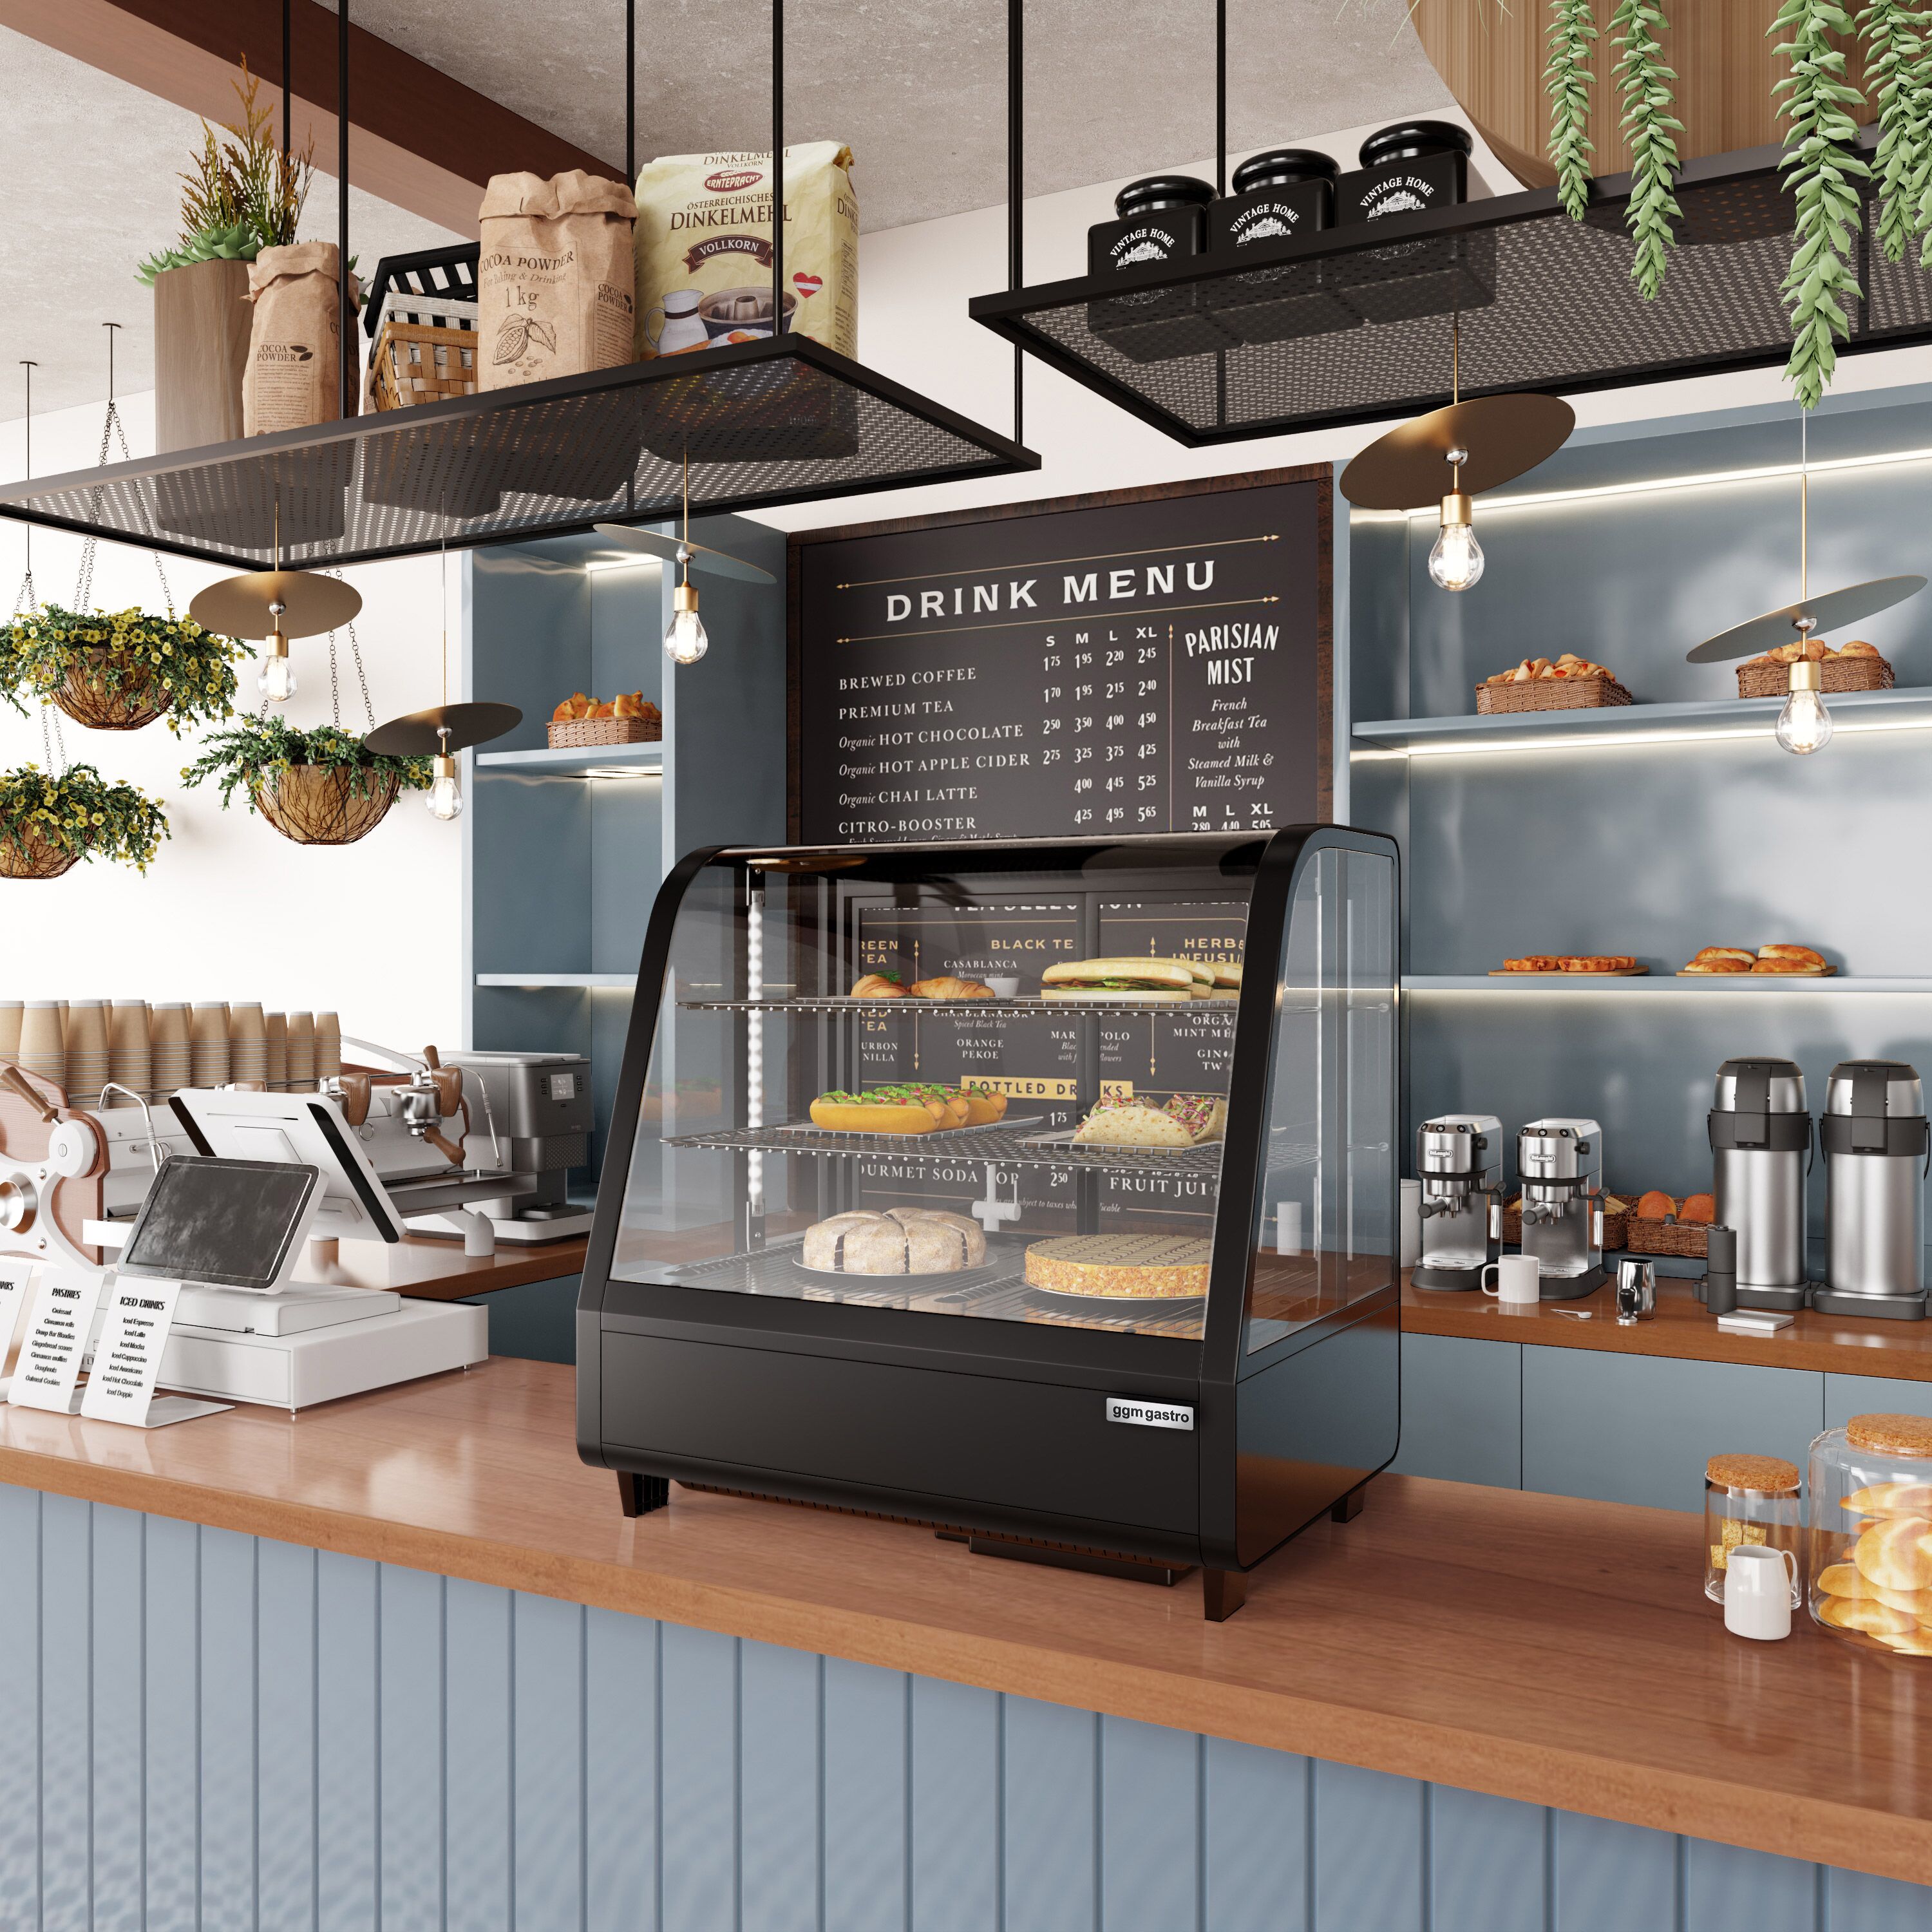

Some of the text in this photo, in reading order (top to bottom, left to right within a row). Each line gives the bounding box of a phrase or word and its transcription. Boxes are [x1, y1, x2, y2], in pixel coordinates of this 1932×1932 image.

[704, 149, 791, 166] DINKELMEL
[706, 175, 761, 189] ERNTEPRACHT
[1359, 176, 1434, 207] VINTAGE HOME
[687, 193, 773, 211] ÖSTERREICHISCHES
[1229, 203, 1300, 232] VINTAGE HOME
[699, 240, 759, 255] VOLLKORN
[1110, 228, 1175, 256] VINTAGE HOME
[480, 251, 574, 274] COCOA POWDER
[484, 278, 493, 289] For
[494, 270, 517, 284] Baking
[530, 272, 567, 285] Drinking
[506, 285, 540, 311] 1 kg
[598, 283, 623, 300] COCOA
[598, 292, 628, 313] POWDER
[258, 345, 287, 354] COCOA
[257, 353, 296, 362] POWDER
[886, 560, 1215, 621] DRINK MENU
[1046, 627, 1157, 647] S M L XL
[1185, 623, 1279, 657] PARISIAN
[1208, 657, 1255, 685] MIST
[839, 674, 905, 690] BREWED
[912, 668, 976, 685] COFFEE
[839, 703, 915, 719] PREMIUM
[922, 701, 953, 713] TEA
[1211, 697, 1247, 712] French
[1192, 715, 1267, 734] Breakfast Tea
[839, 735, 875, 751] Organic
[880, 732, 913, 745] HOT
[918, 724, 1023, 743] CHOCOLATE
[1218, 736, 1240, 749] with
[839, 763, 875, 779] Organic
[880, 761, 913, 773] HOT
[918, 757, 969, 772] APPLE
[976, 753, 1030, 768] CIDER
[1188, 753, 1274, 770] Steamed Milk &
[1195, 774, 1265, 790] Vanilla Syrup
[839, 792, 875, 808] Organic
[878, 790, 918, 803] CHAI
[927, 787, 978, 800] LATTE
[1193, 803, 1273, 817] M L XL
[838, 817, 976, 834] CITRO-BOOSTER
[862, 940, 898, 950] REEN
[991, 939, 1077, 949] BLACK TE
[1185, 938, 1244, 950] HERB
[862, 954, 887, 963] EA
[1173, 952, 1242, 963] INFUSI
[862, 1021, 887, 1031] EA
[954, 1020, 974, 1029] Spiced
[1051, 1031, 1076, 1039] MAR
[1173, 1028, 1206, 1037] MINT
[956, 1039, 1004, 1048] ORANGE
[863, 1053, 894, 1061] NILLA
[962, 1050, 998, 1059] PEKOE
[969, 1081, 1045, 1094] BOTTLED
[862, 1164, 926, 1179] URMET
[933, 1168, 978, 1182] SODA
[996, 1172, 1019, 1184] OP
[1110, 1177, 1214, 1197] FRUIT JUI
[1019, 1198, 1037, 1209] ubject
[52, 1287, 81, 1300] PASTRIES
[120, 1296, 166, 1311] ICED DRINKS
[52, 1307, 72, 1316] Croissant
[44, 1318, 65, 1327] Cinnamon
[133, 1318, 154, 1327] Espresso
[32, 1340, 57, 1349] Gingerbread
[30, 1352, 52, 1360] Cinnamon
[121, 1354, 147, 1363] Cappuccino
[35, 1364, 57, 1373] Doughnuts
[119, 1365, 143, 1375] Americano
[25, 1374, 61, 1386] Oatmeal Cookies
[121, 1378, 143, 1387] Chocolate
[106, 1388, 133, 1399] Iced Doppio
[1113, 1406, 1189, 1423] ggm gastro
